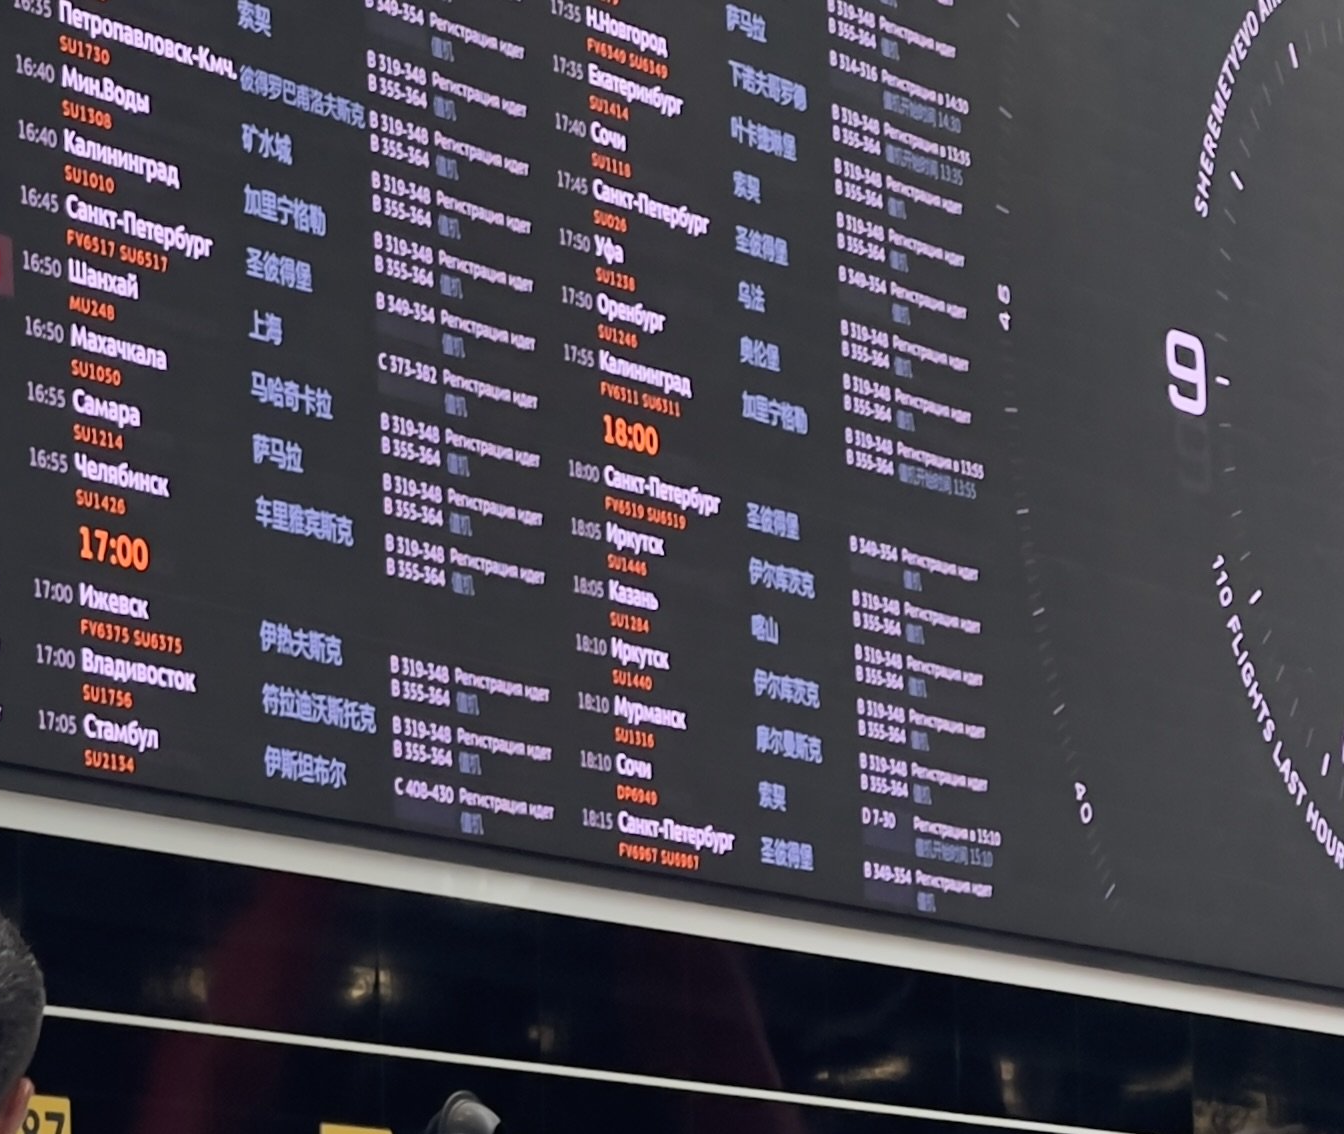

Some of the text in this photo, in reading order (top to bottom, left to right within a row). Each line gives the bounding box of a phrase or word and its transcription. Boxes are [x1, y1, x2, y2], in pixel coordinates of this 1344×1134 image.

[58, 0, 238, 81] Петропавловск-Кмч.
[15, 53, 150, 114] 16:40 Мин.Воды
[1194, 10, 1260, 218] SHEREMETYEVO
[593, 234, 624, 265] Уфа
[22, 249, 139, 300] 16:50 Шанхай
[596, 292, 666, 334] Оренбург
[70, 323, 168, 371] Махачкала
[1165, 329, 1208, 416] 9
[72, 388, 141, 429] Самара
[603, 414, 659, 456] 18:00
[73, 452, 170, 498] Челябинск
[79, 525, 149, 571] 17:00
[34, 577, 149, 620] 17:00 Ижевск
[608, 578, 659, 611] Казань
[1212, 554, 1234, 607] 110
[1226, 613, 1276, 742] FLIGHTS
[1272, 740, 1307, 806] LAST
[38, 709, 159, 753] 17:05 Стамбул
[613, 694, 687, 730] Мурманск
[582, 807, 736, 855] 18:15 Санкт-Петербург
